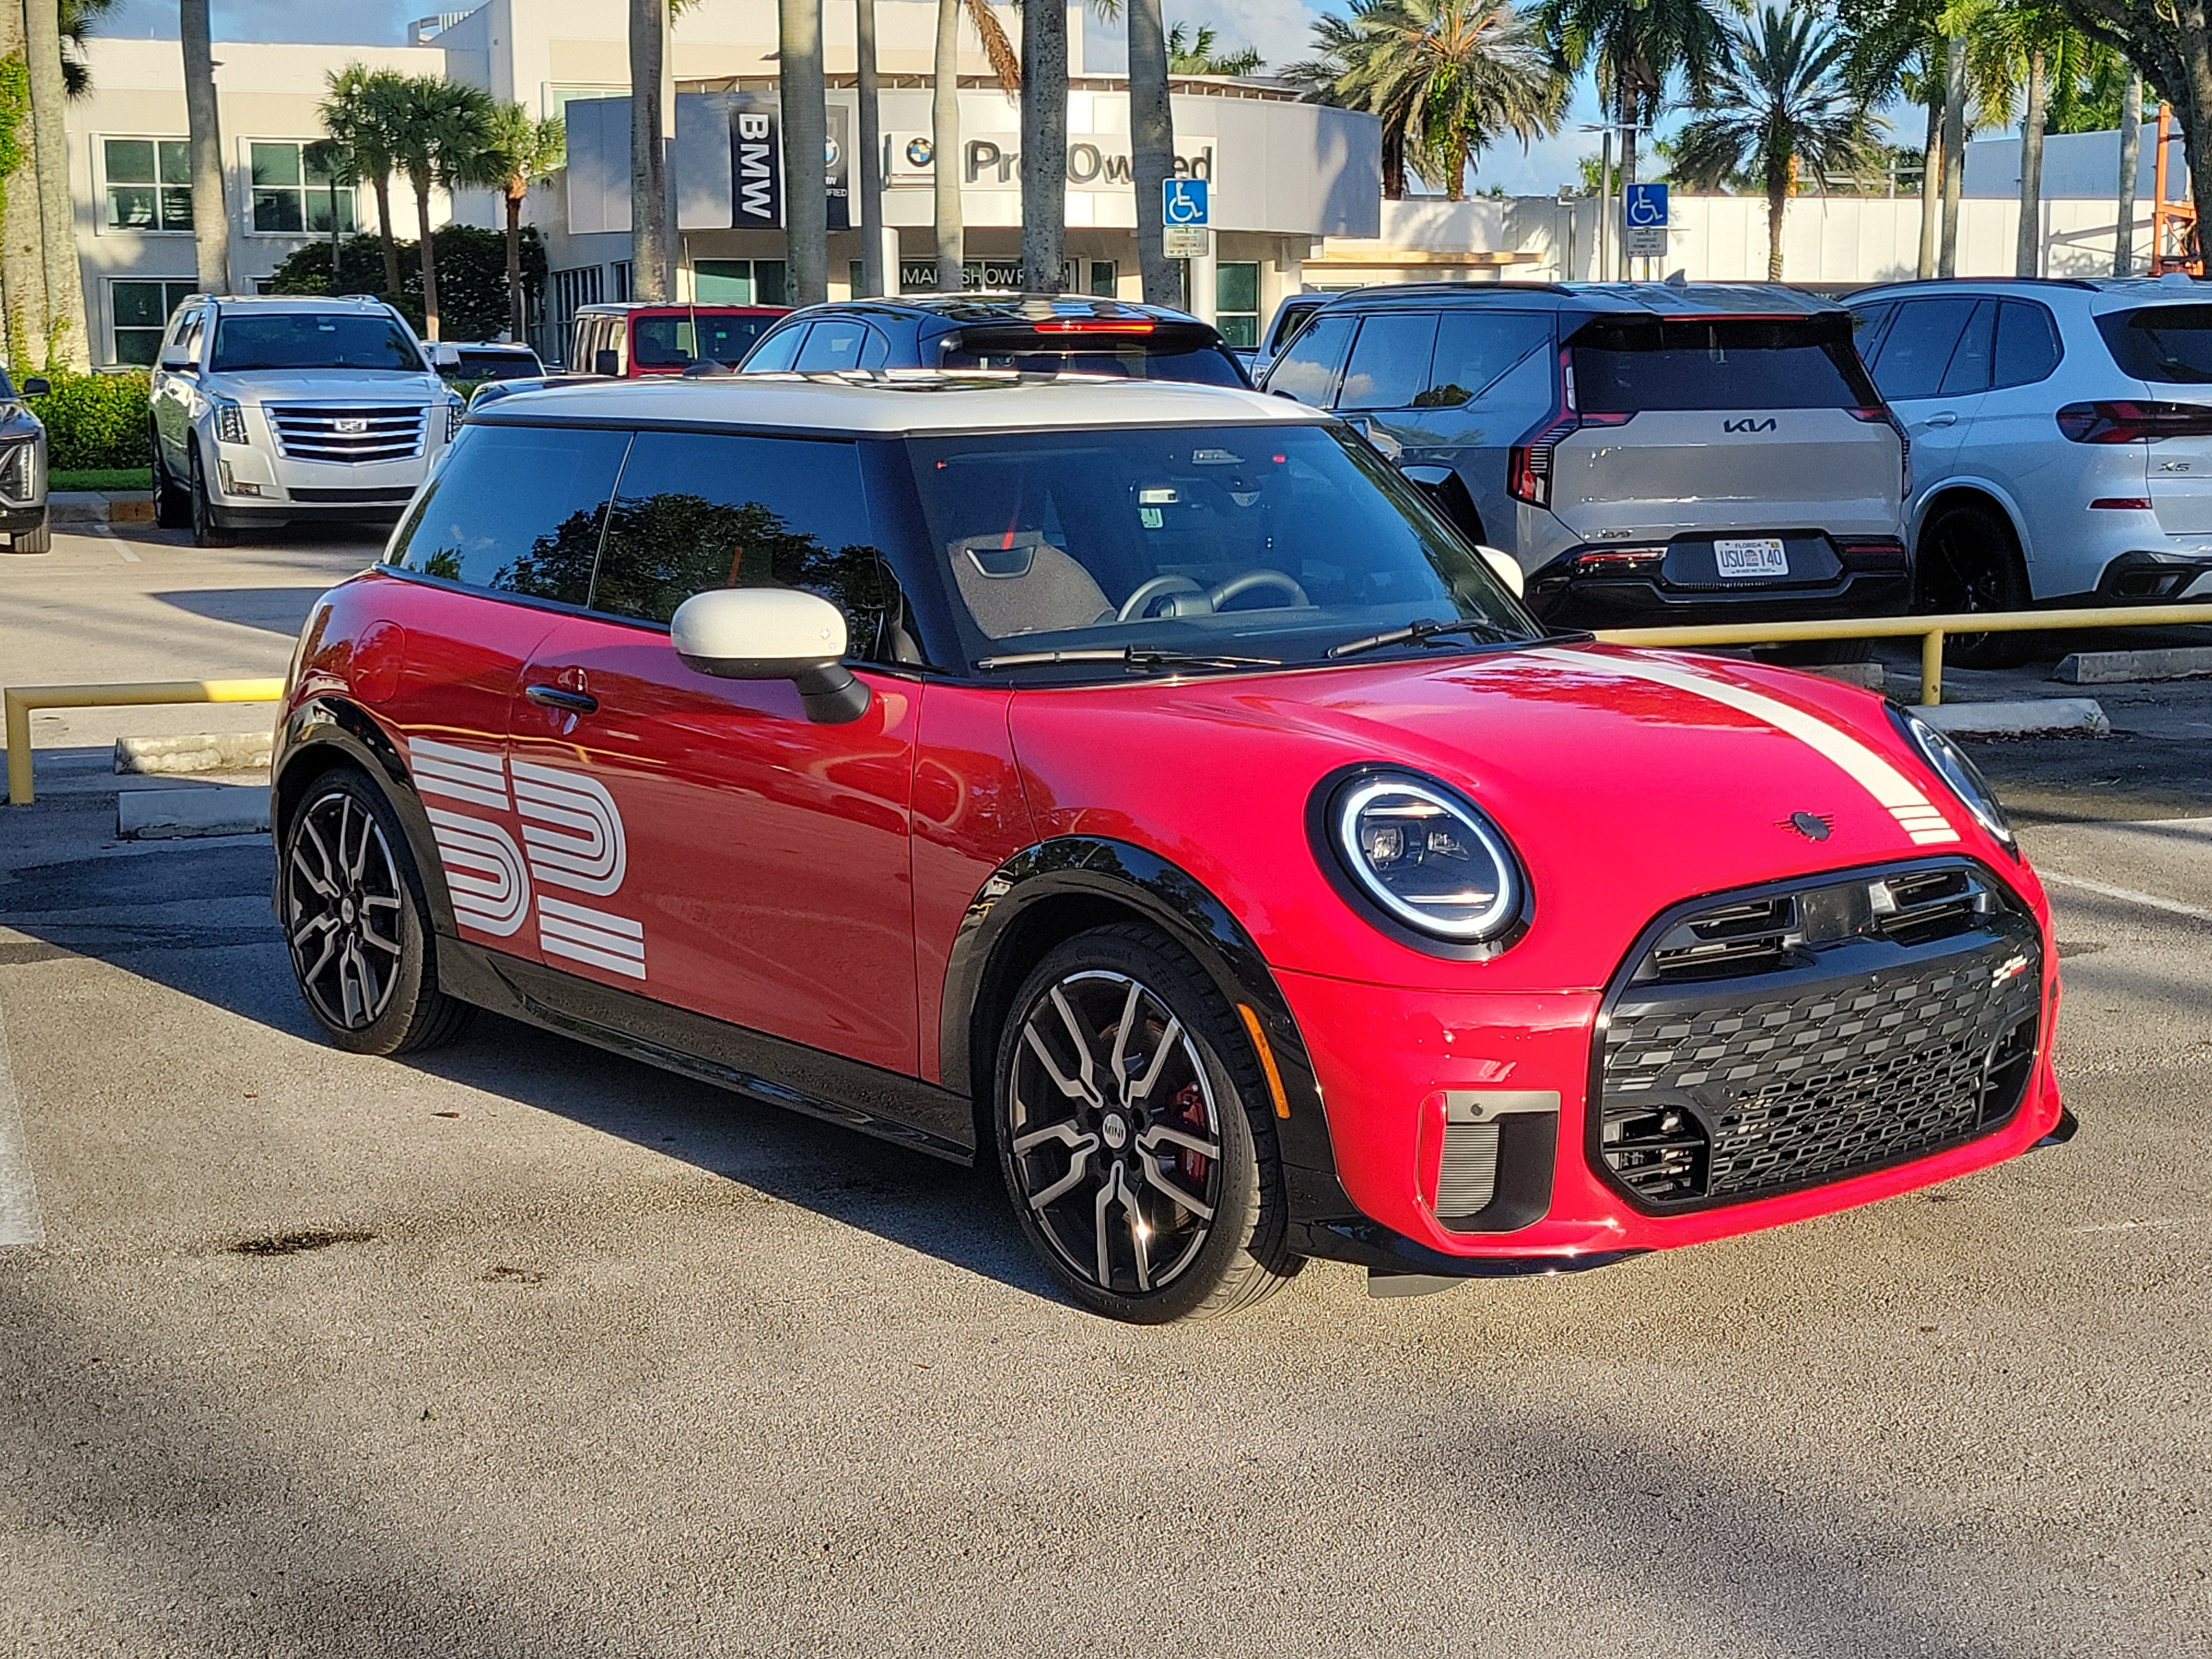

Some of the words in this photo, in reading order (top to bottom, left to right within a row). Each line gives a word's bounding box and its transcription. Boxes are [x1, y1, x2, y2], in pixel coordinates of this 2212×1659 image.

[739, 114, 771, 218] BMW
[1069, 143, 1212, 184] Owed
[903, 268, 938, 284] MAI
[1723, 419, 1776, 432] KIA
[2158, 461, 2191, 472] X5
[1720, 550, 1745, 567] USU
[1759, 549, 1782, 566] 140
[1104, 1123, 1124, 1139] MINI
